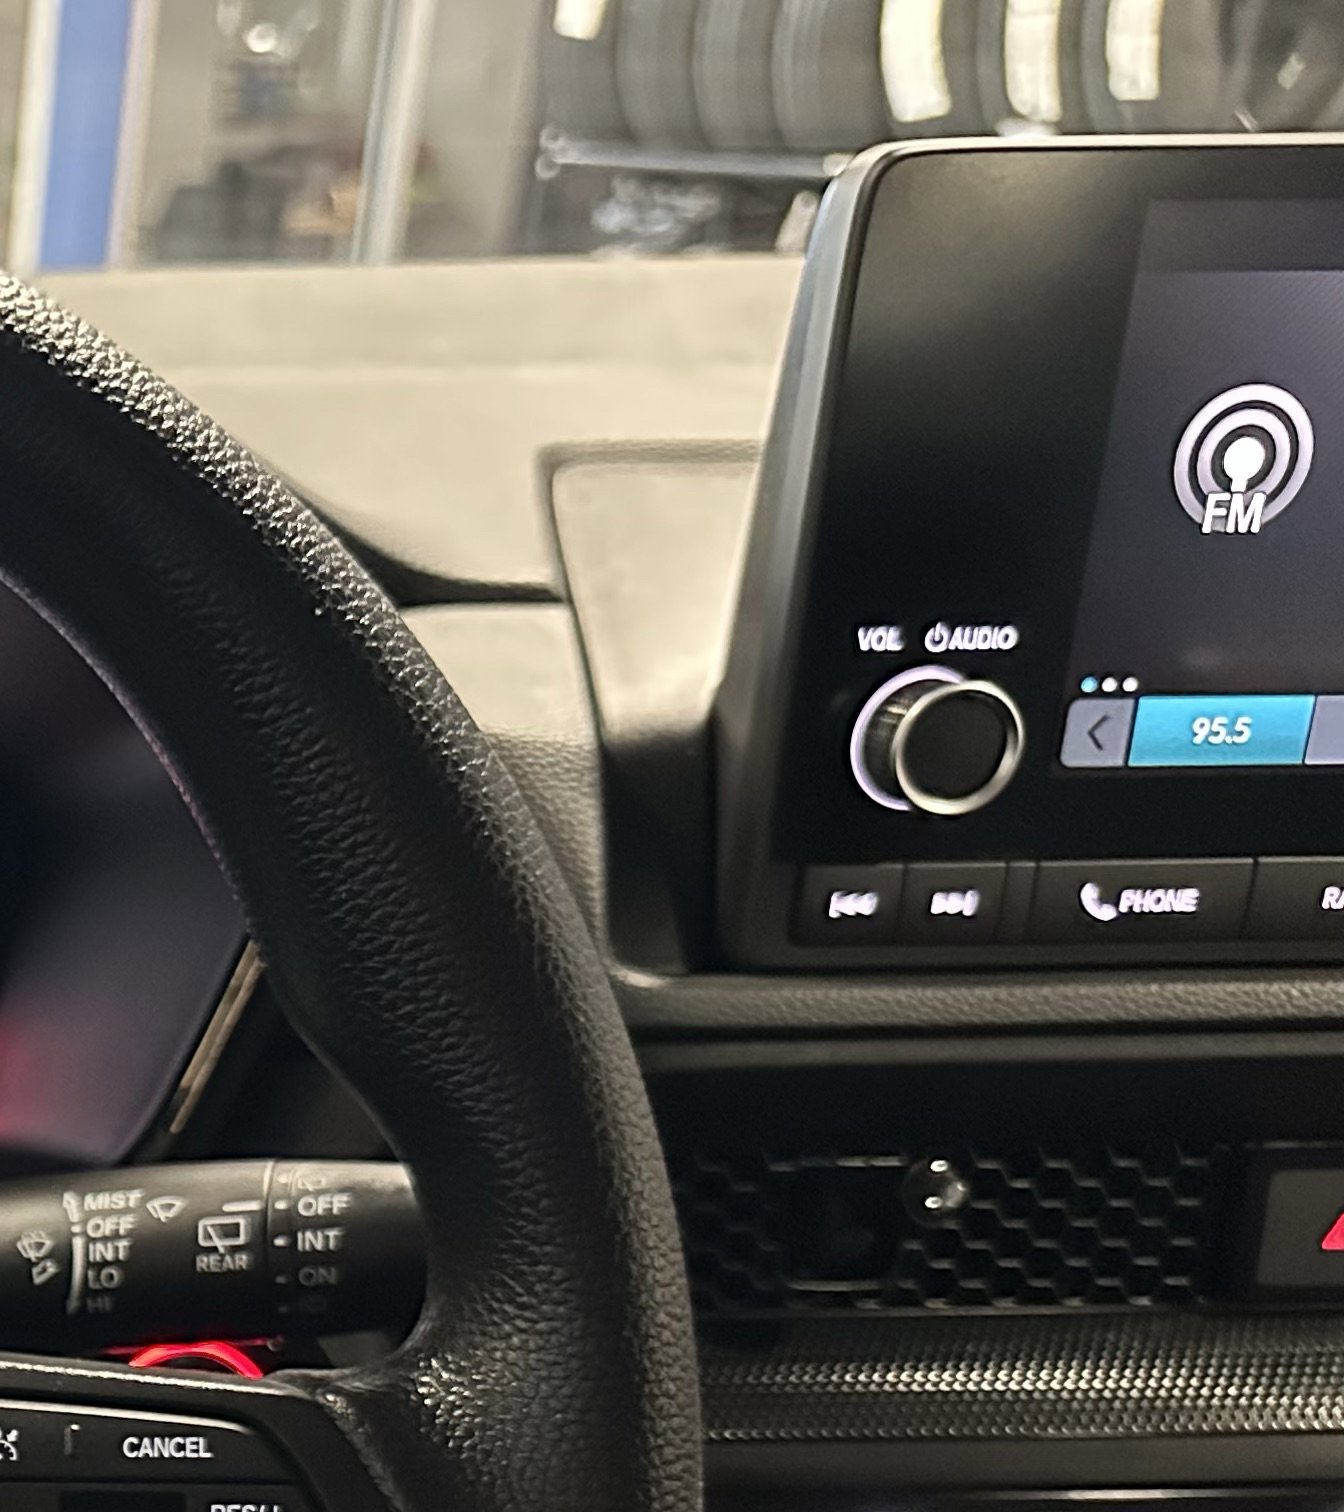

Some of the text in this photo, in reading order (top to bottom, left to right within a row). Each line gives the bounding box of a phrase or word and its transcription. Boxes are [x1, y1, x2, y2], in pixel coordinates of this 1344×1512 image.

[1202, 494, 1267, 534] FM
[857, 625, 904, 652] VOL
[949, 625, 1019, 651] AUDIO
[1190, 715, 1254, 748] 95.5
[1118, 887, 1201, 913] PHONE
[1321, 885, 1344, 910] R
[83, 1188, 142, 1211] MIST
[296, 1193, 351, 1217] OFF
[85, 1215, 135, 1238] OFF
[87, 1238, 132, 1263] INT
[296, 1227, 346, 1253] INT
[194, 1252, 250, 1274] REAR
[297, 1263, 338, 1288] ON
[86, 1268, 123, 1290] LO
[122, 1436, 213, 1458] CANCEL
